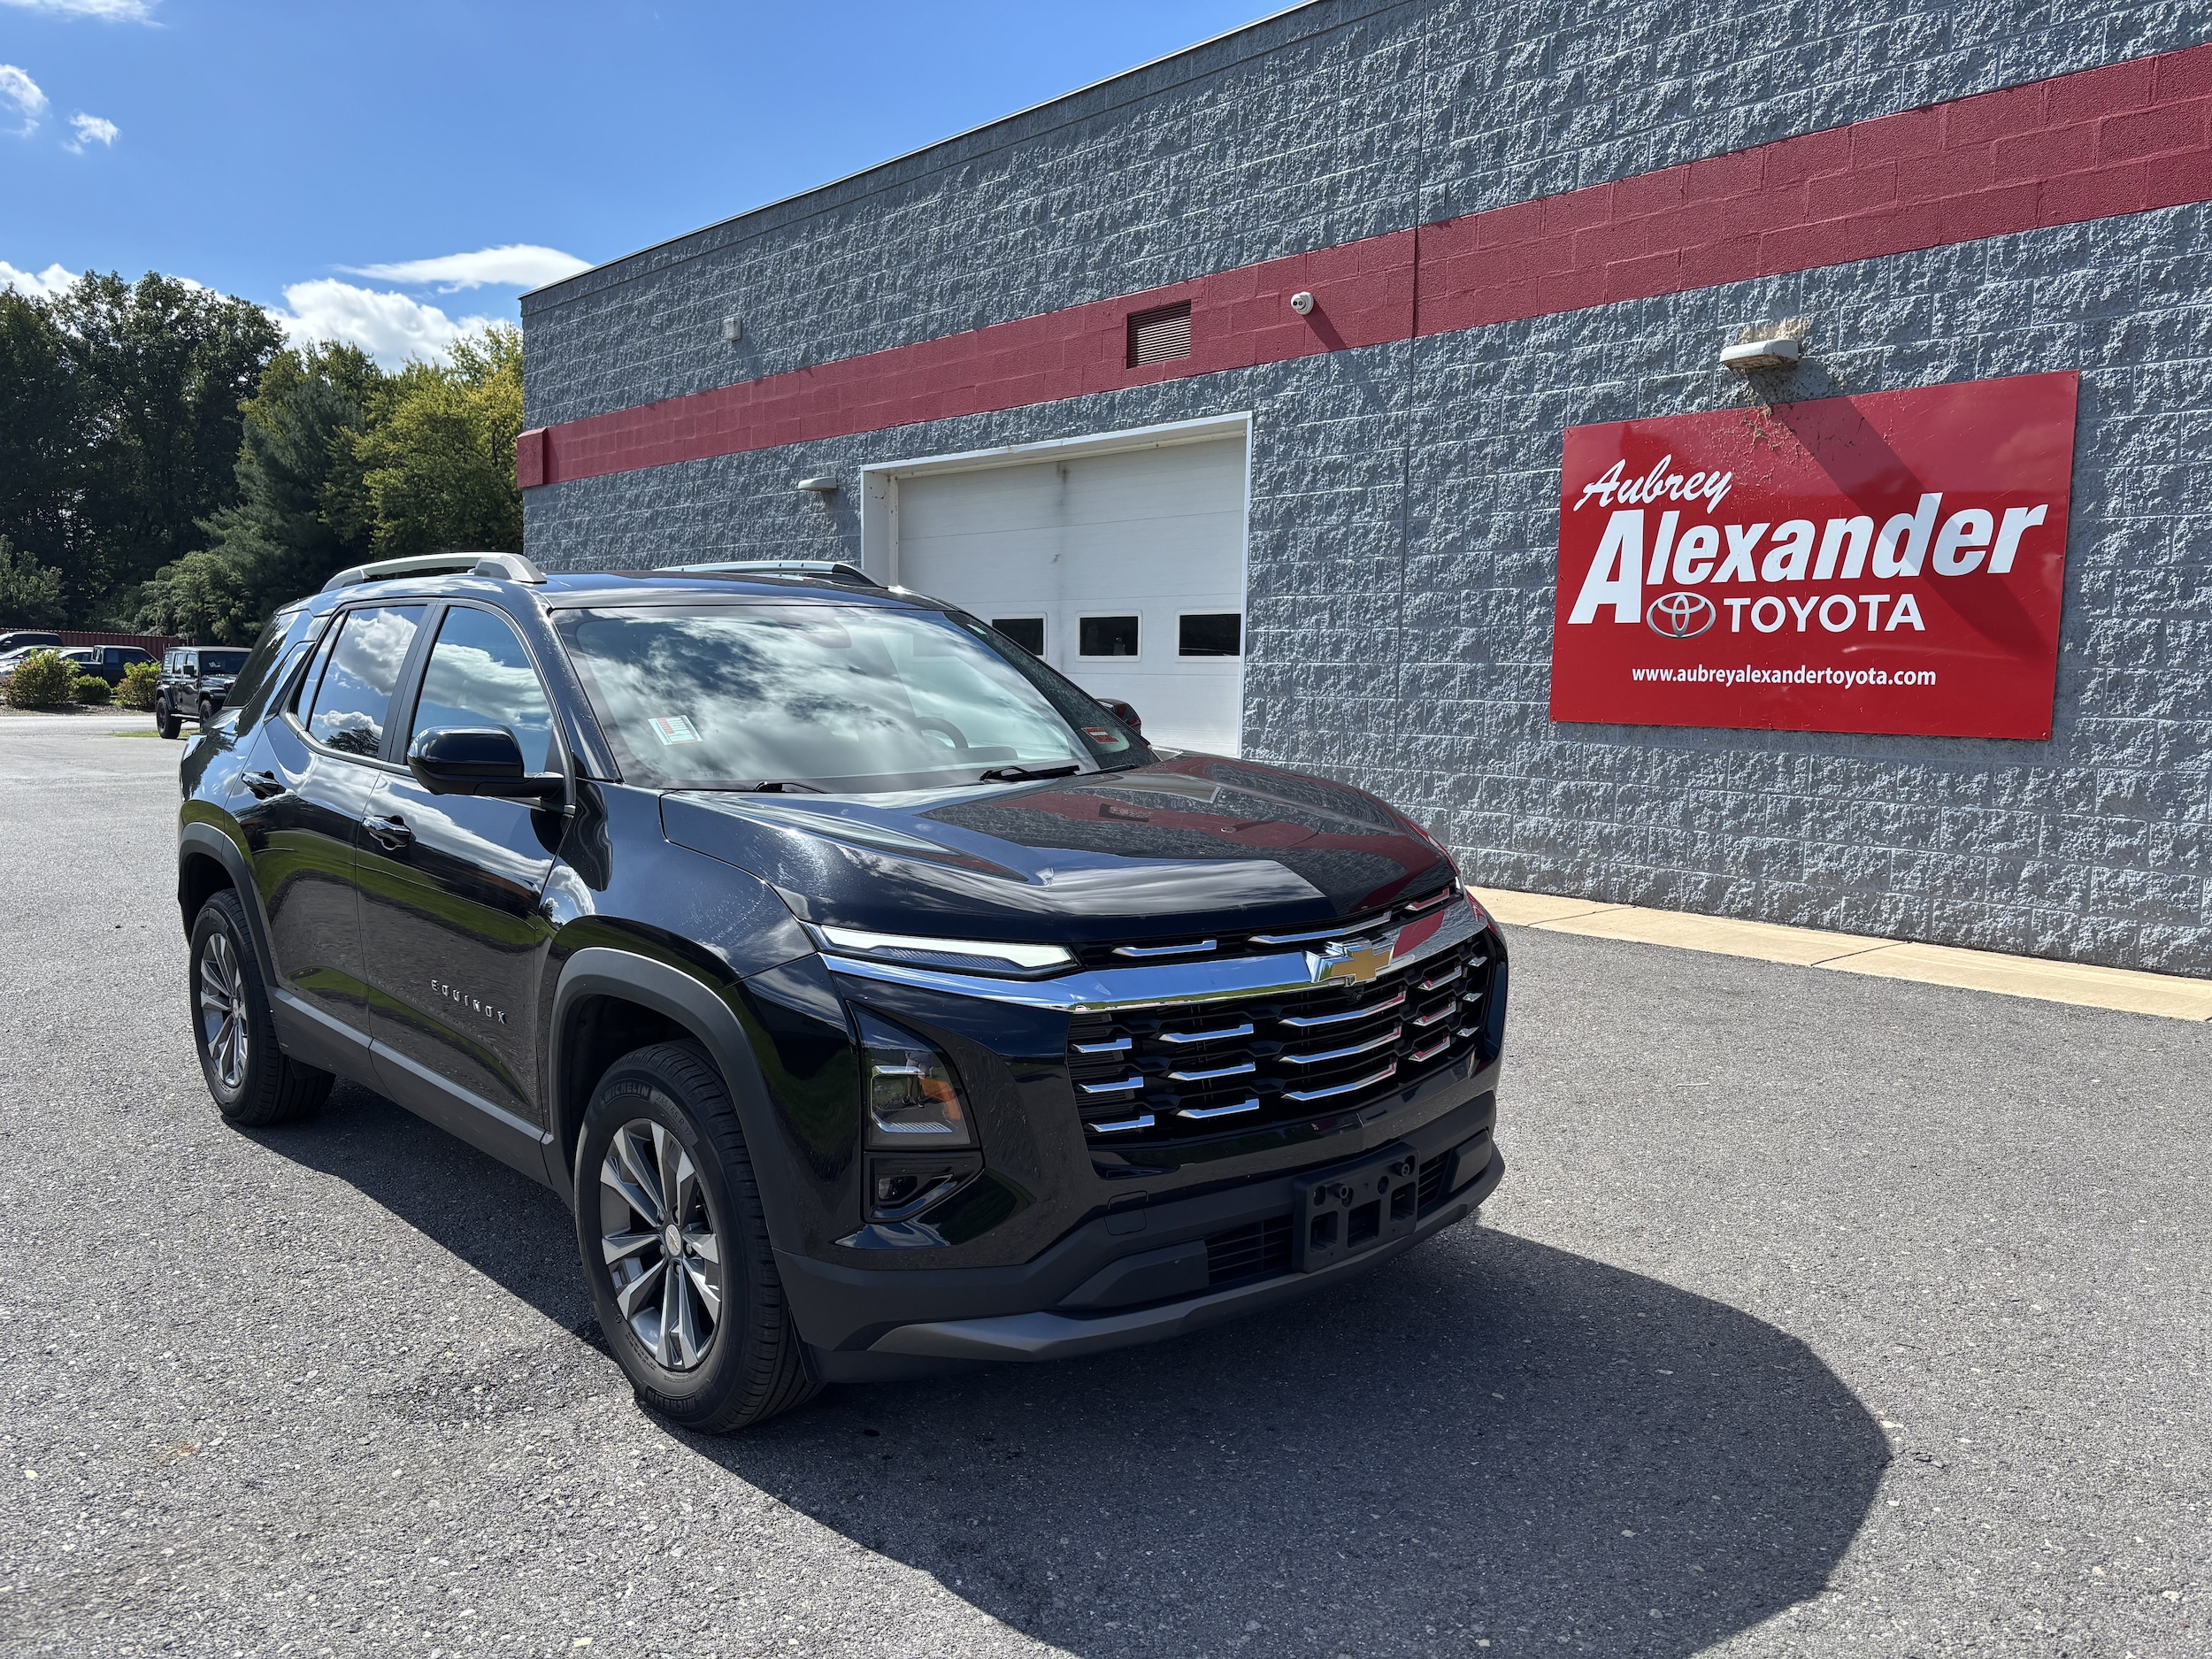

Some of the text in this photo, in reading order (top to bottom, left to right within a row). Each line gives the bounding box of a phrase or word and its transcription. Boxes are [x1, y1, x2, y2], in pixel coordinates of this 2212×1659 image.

[1573, 454, 1732, 514] Aubrey
[1567, 492, 2048, 625] Alexander
[1724, 594, 1926, 634] TOYOTA
[1632, 664, 1936, 689] www.aubreyalexandertoyota.com
[431, 979, 507, 1025] EQUINOX
[604, 1082, 650, 1103] MICHELIN
[647, 1390, 696, 1413] MICHELIN
